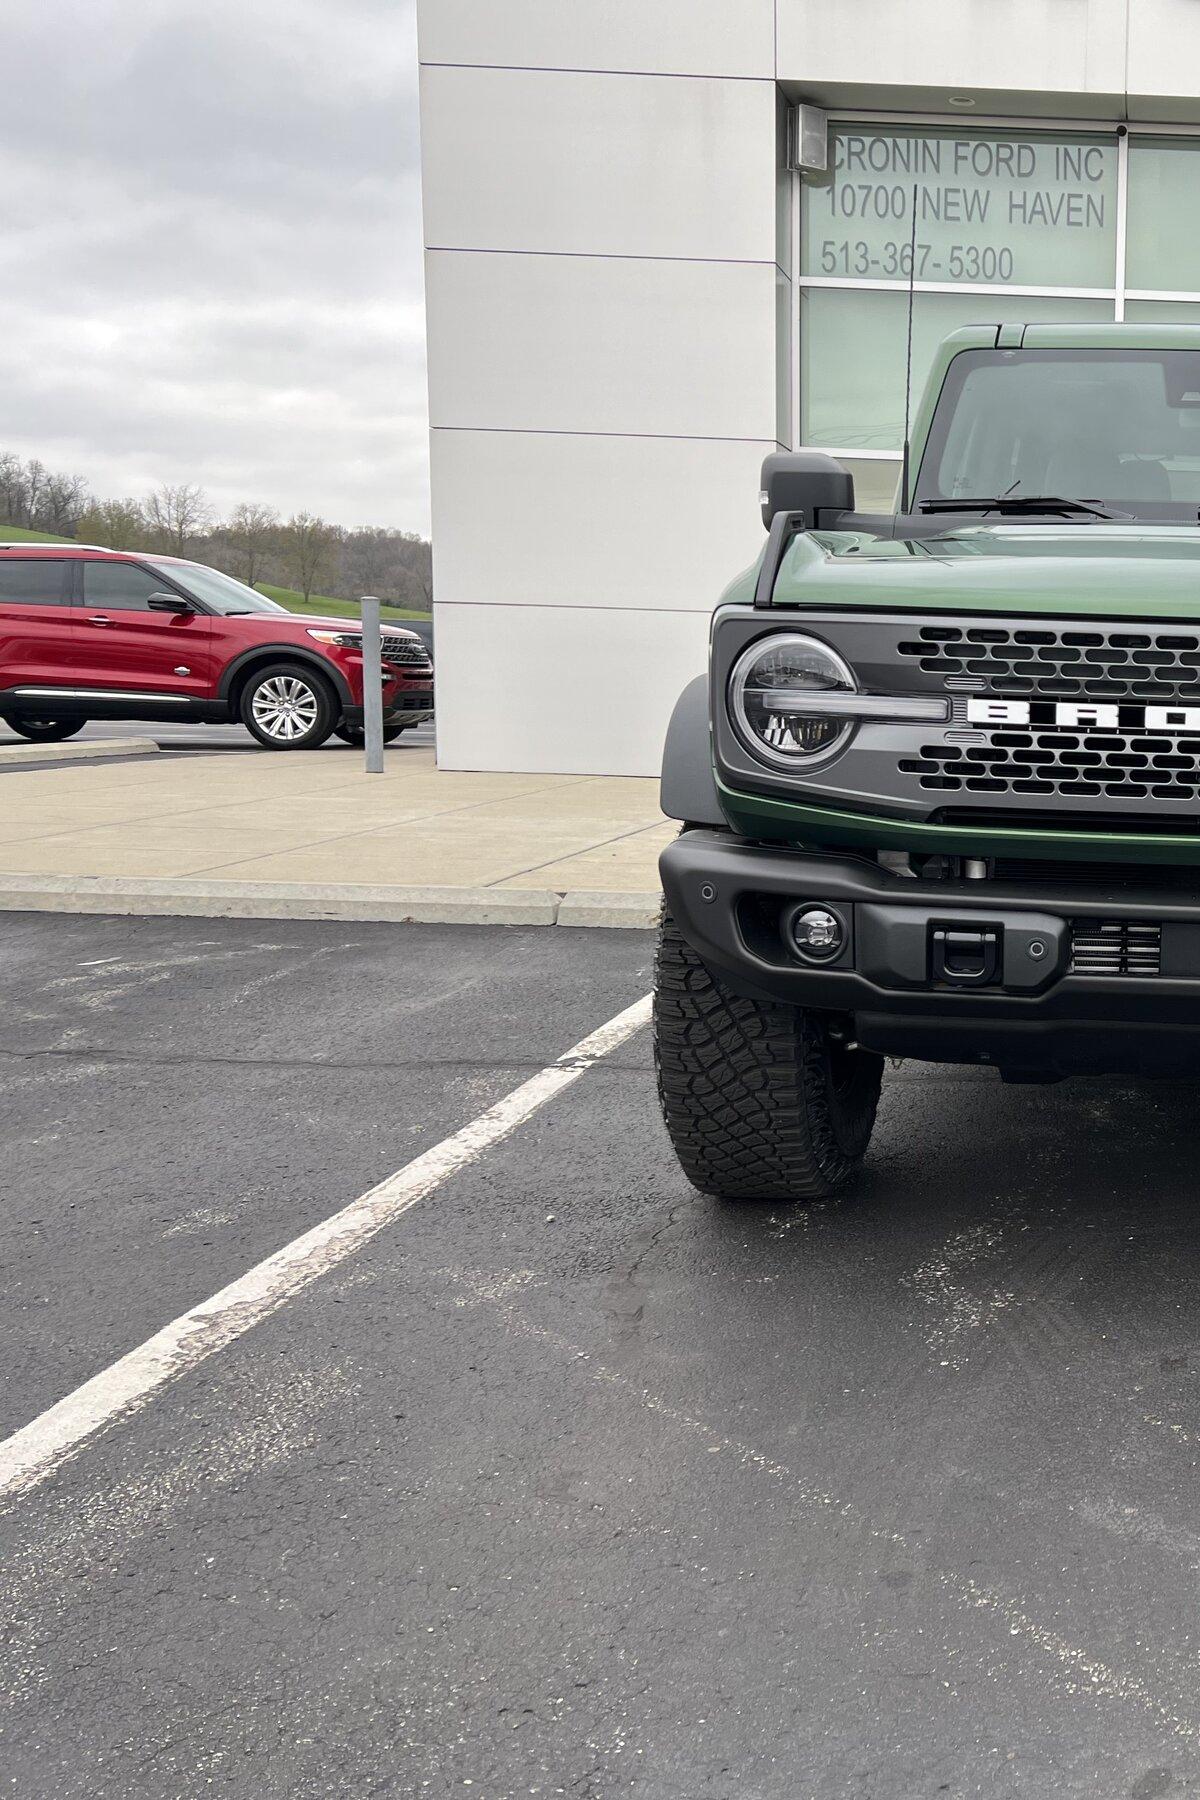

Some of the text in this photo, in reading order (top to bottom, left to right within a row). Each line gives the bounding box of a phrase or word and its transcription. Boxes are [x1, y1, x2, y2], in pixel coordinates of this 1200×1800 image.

[831, 136, 1104, 182] CRONIN FORD INC
[826, 183, 1104, 228] 10700 NEW HAVEN
